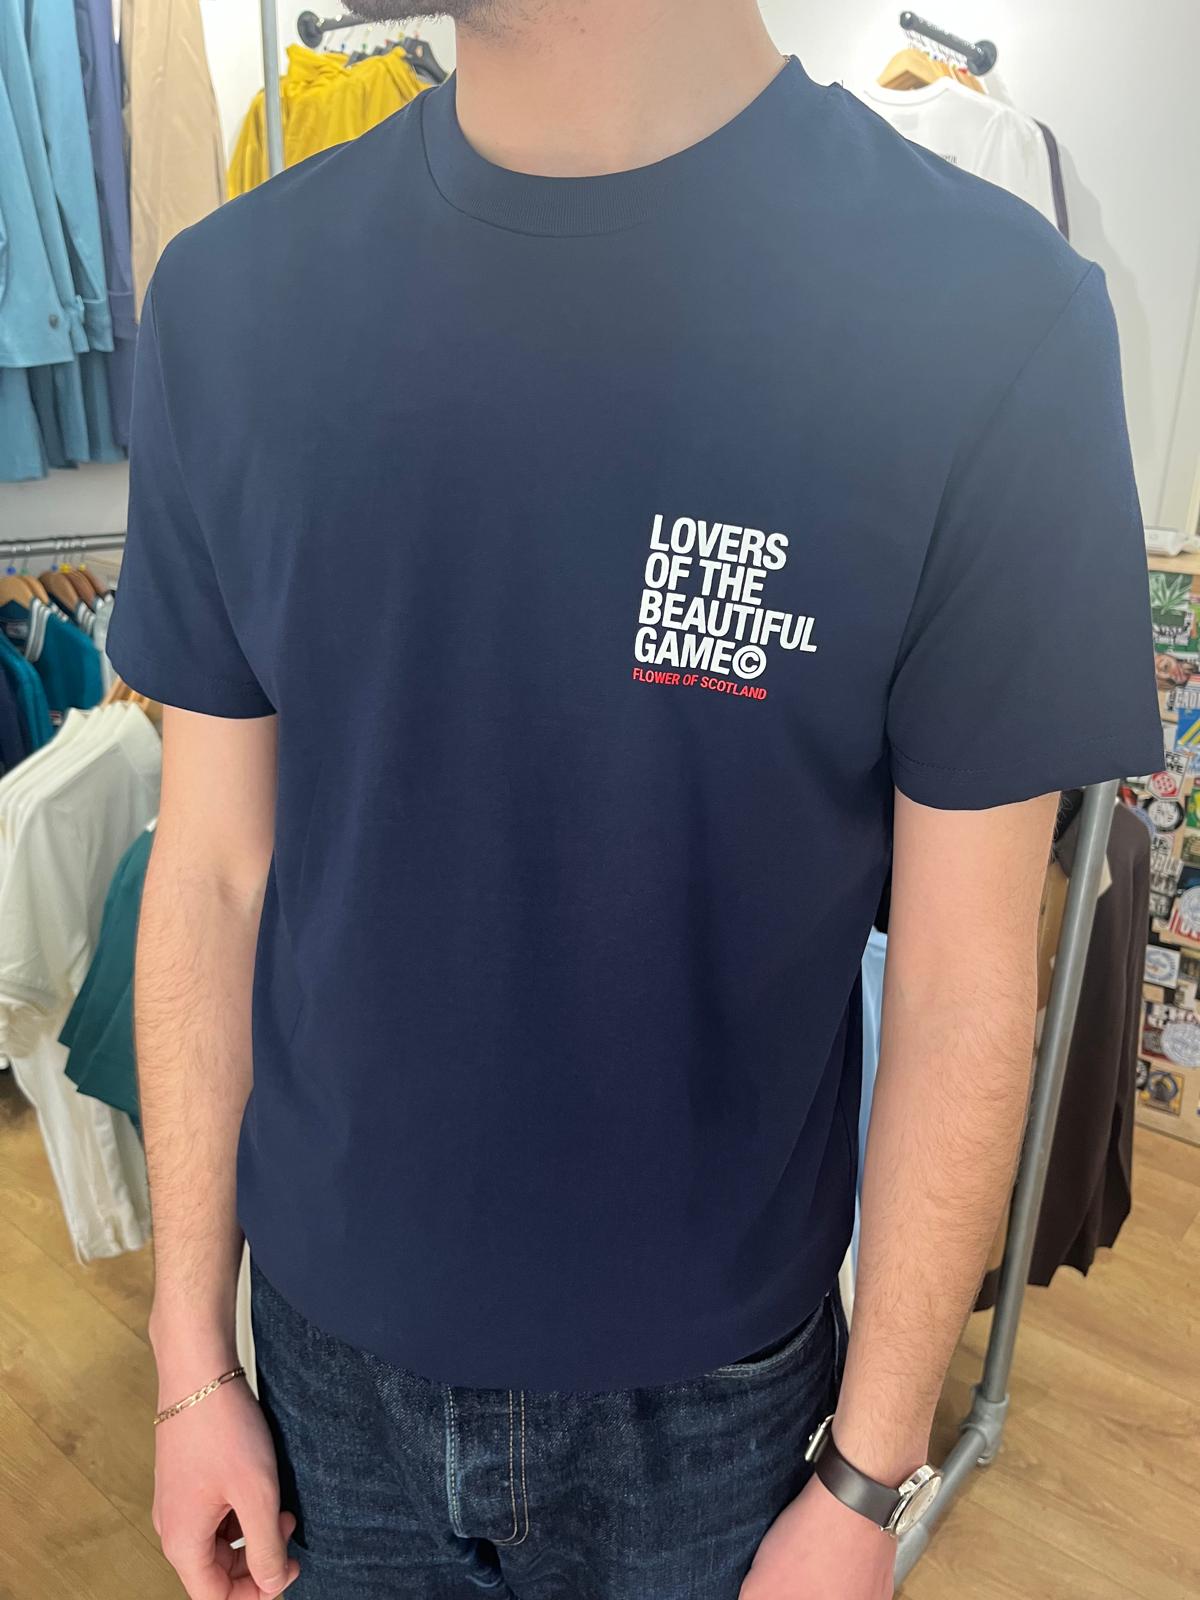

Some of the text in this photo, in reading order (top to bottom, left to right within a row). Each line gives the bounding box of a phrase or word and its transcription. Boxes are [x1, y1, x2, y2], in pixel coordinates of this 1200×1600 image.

[650, 514, 788, 570] LOVERS
[644, 552, 767, 605] OF THE
[639, 589, 817, 652] BEAUTIFUL
[633, 668, 767, 700] FLOWER OF SCOTLAND
